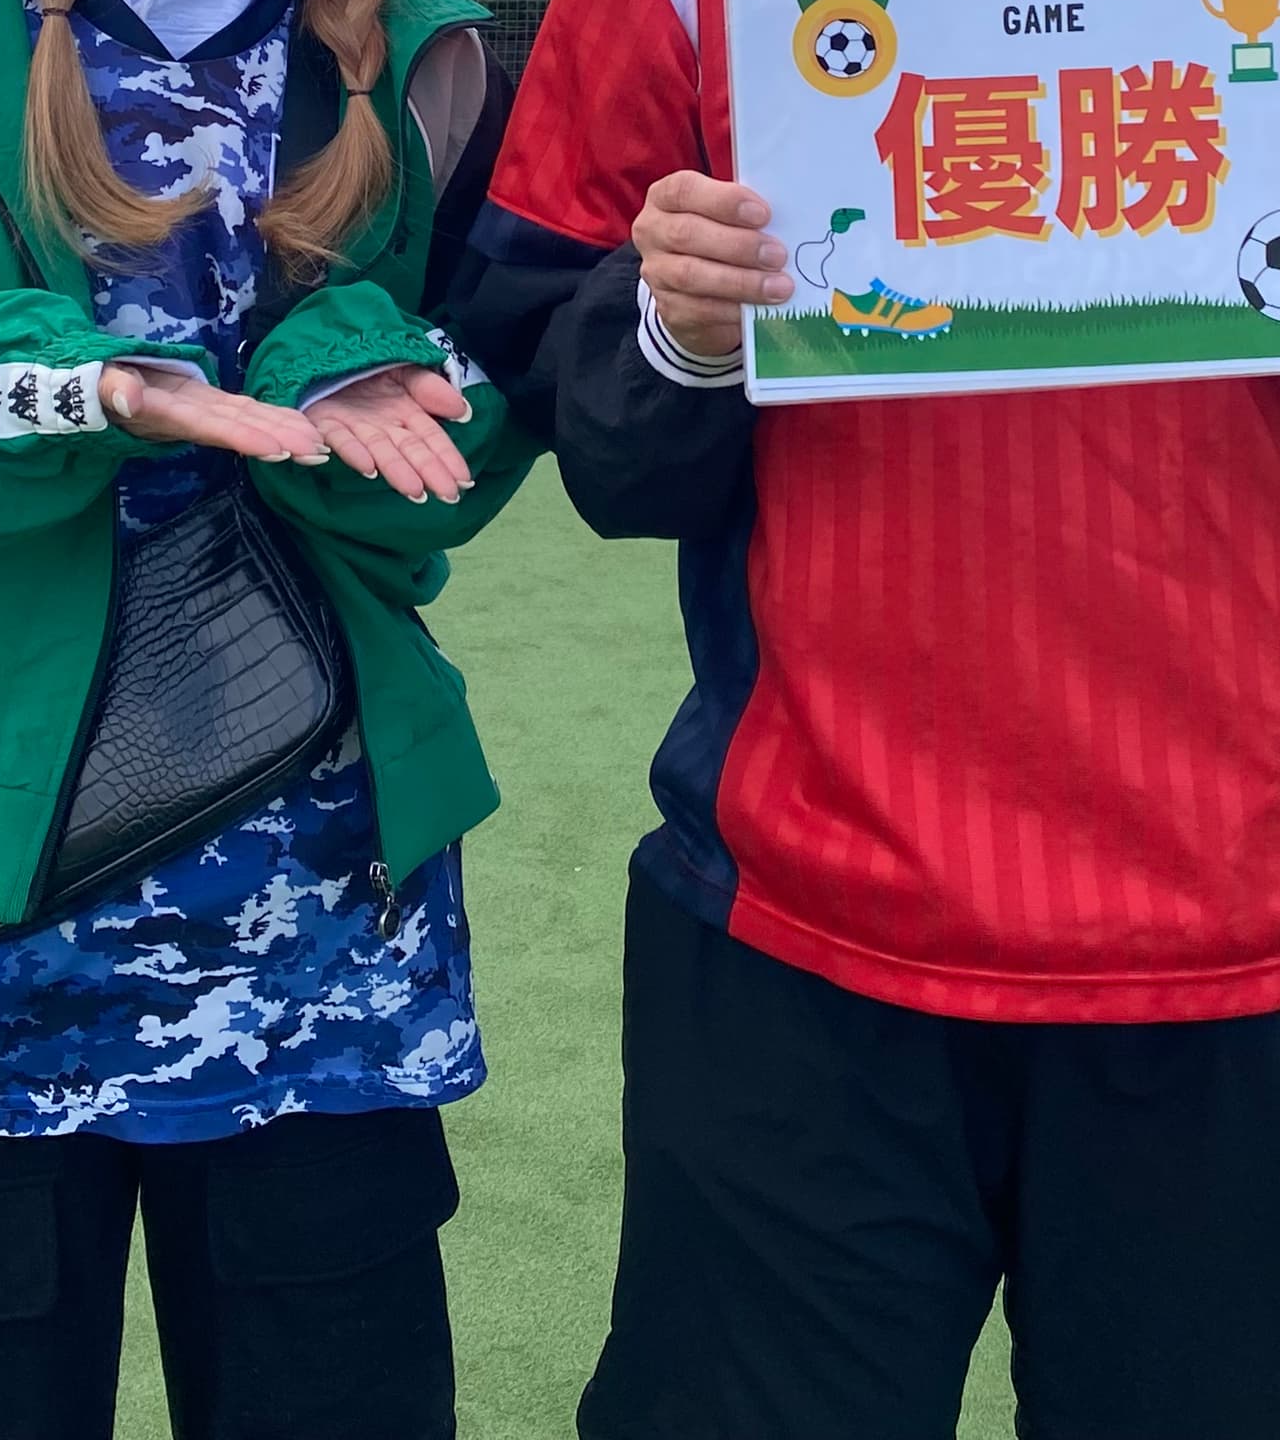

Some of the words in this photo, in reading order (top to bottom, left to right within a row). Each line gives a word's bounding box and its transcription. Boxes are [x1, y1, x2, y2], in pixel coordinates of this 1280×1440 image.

[1003, 3, 1085, 36] GAME
[874, 60, 1232, 248] 優勝
[70, 375, 88, 427] Kappa
